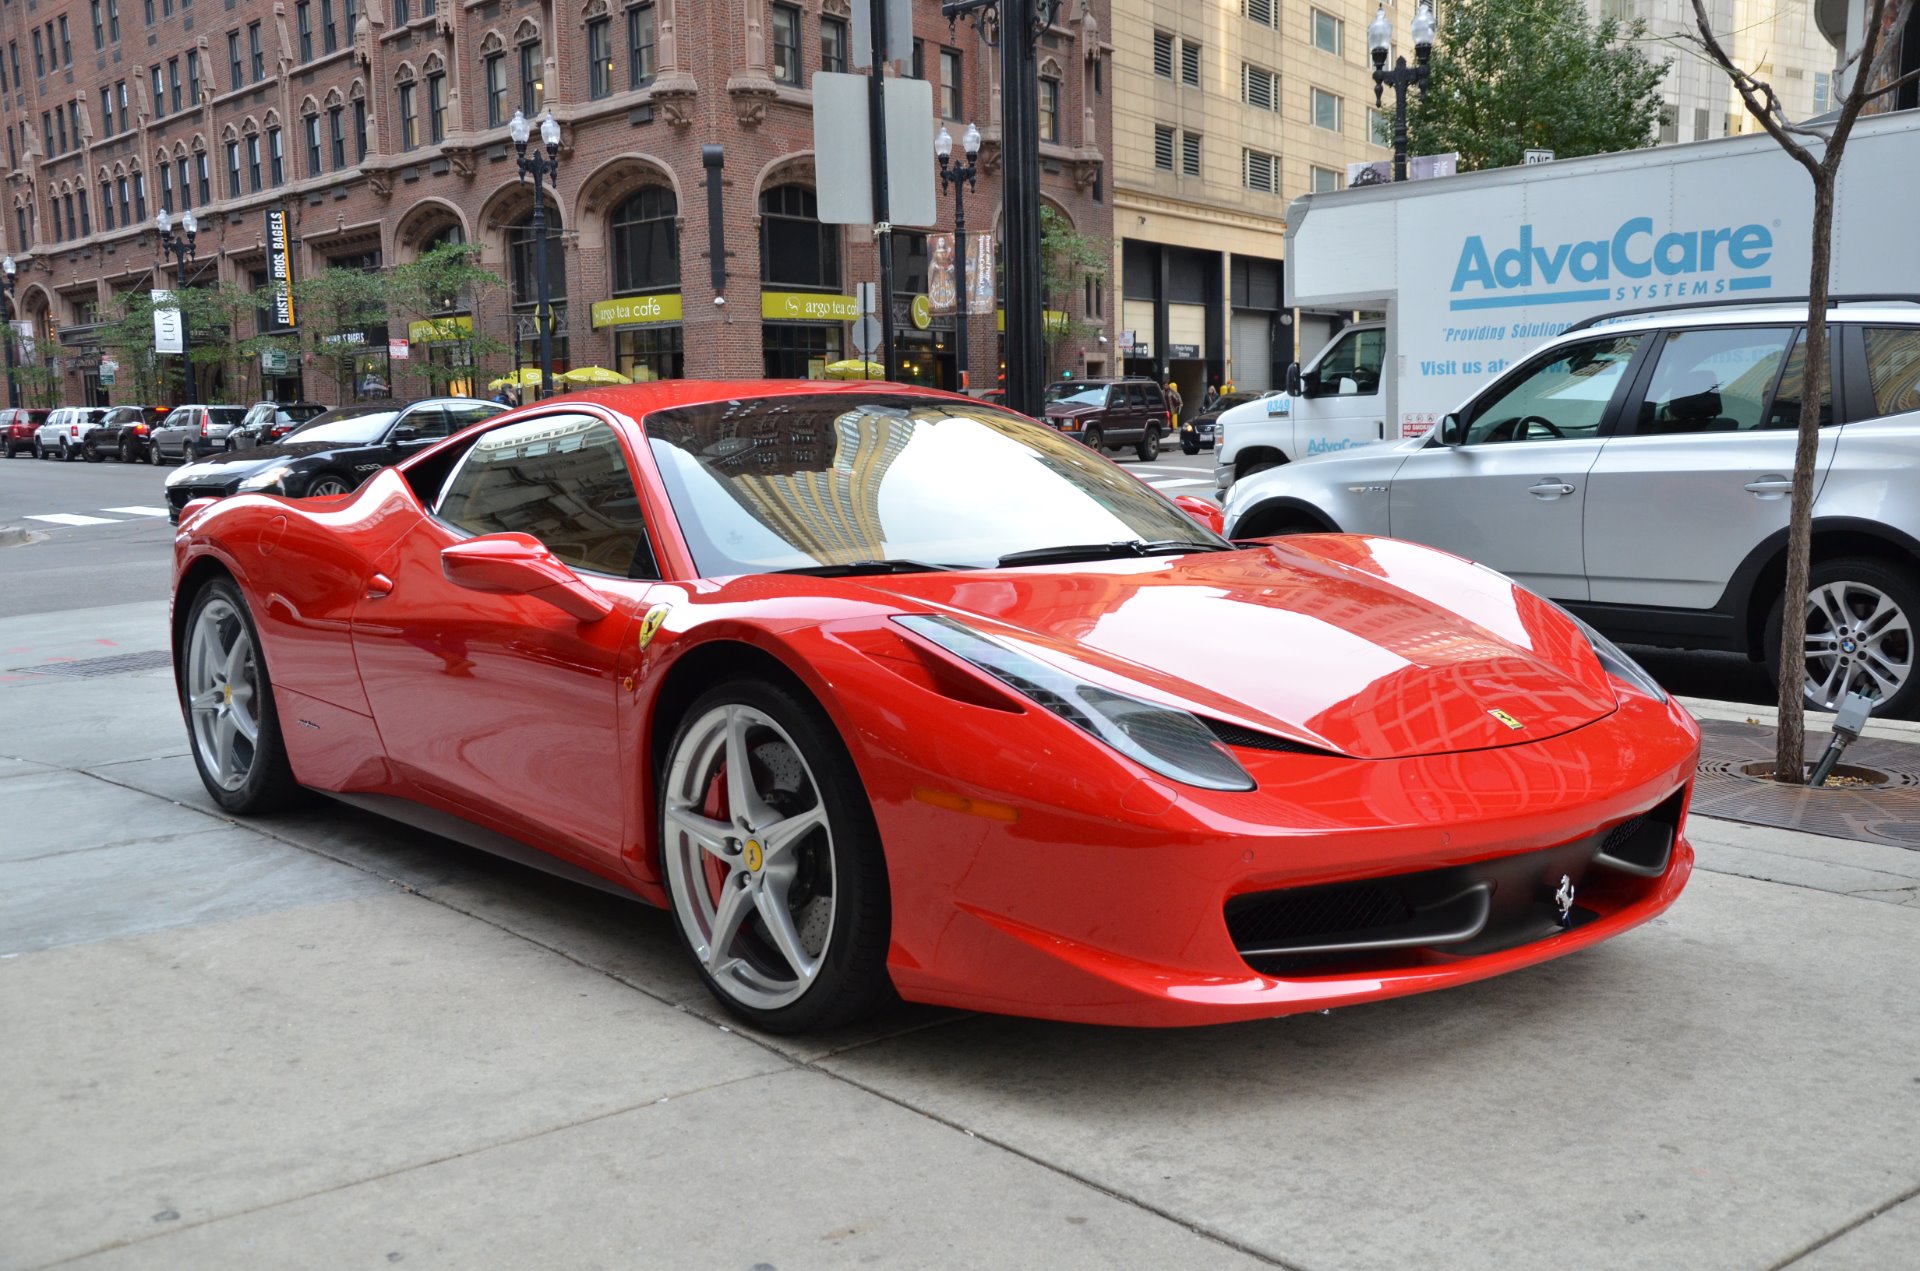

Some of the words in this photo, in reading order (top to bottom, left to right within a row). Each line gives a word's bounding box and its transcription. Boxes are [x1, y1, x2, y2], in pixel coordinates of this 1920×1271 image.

[270, 212, 284, 249] BAGELS
[273, 252, 286, 278] BROS.
[1450, 217, 1773, 292] AdvaCare
[1616, 279, 1725, 300] SYSTEMS
[617, 305, 630, 318] tea
[633, 297, 661, 316] café
[805, 302, 831, 318] argo
[833, 301, 845, 315] tea
[1420, 361, 1457, 376] Visit
[1462, 361, 1482, 375] us
[1267, 400, 1290, 412] 0349
